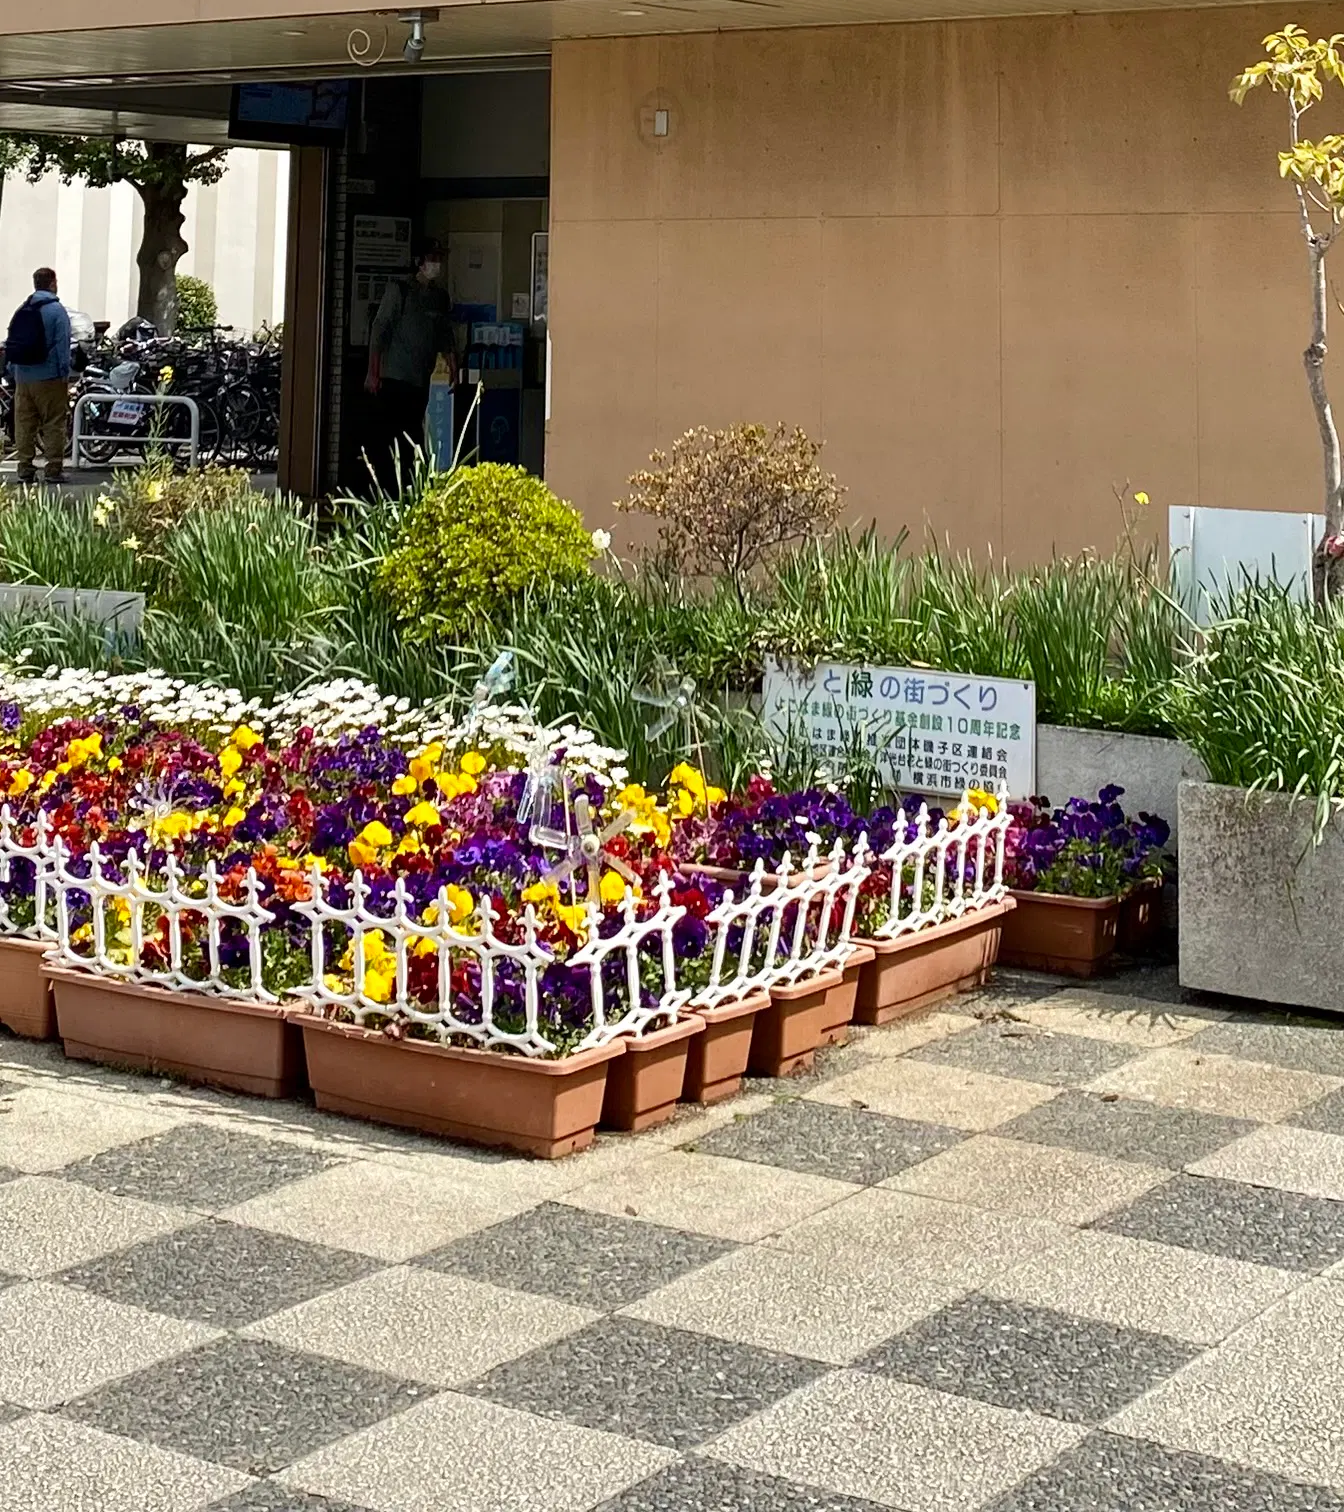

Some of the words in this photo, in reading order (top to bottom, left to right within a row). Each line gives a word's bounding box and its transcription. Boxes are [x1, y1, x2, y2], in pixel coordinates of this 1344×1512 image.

[816, 669, 998, 712] と緑の街づくり
[913, 771, 1009, 794] 横浜市緑の協
